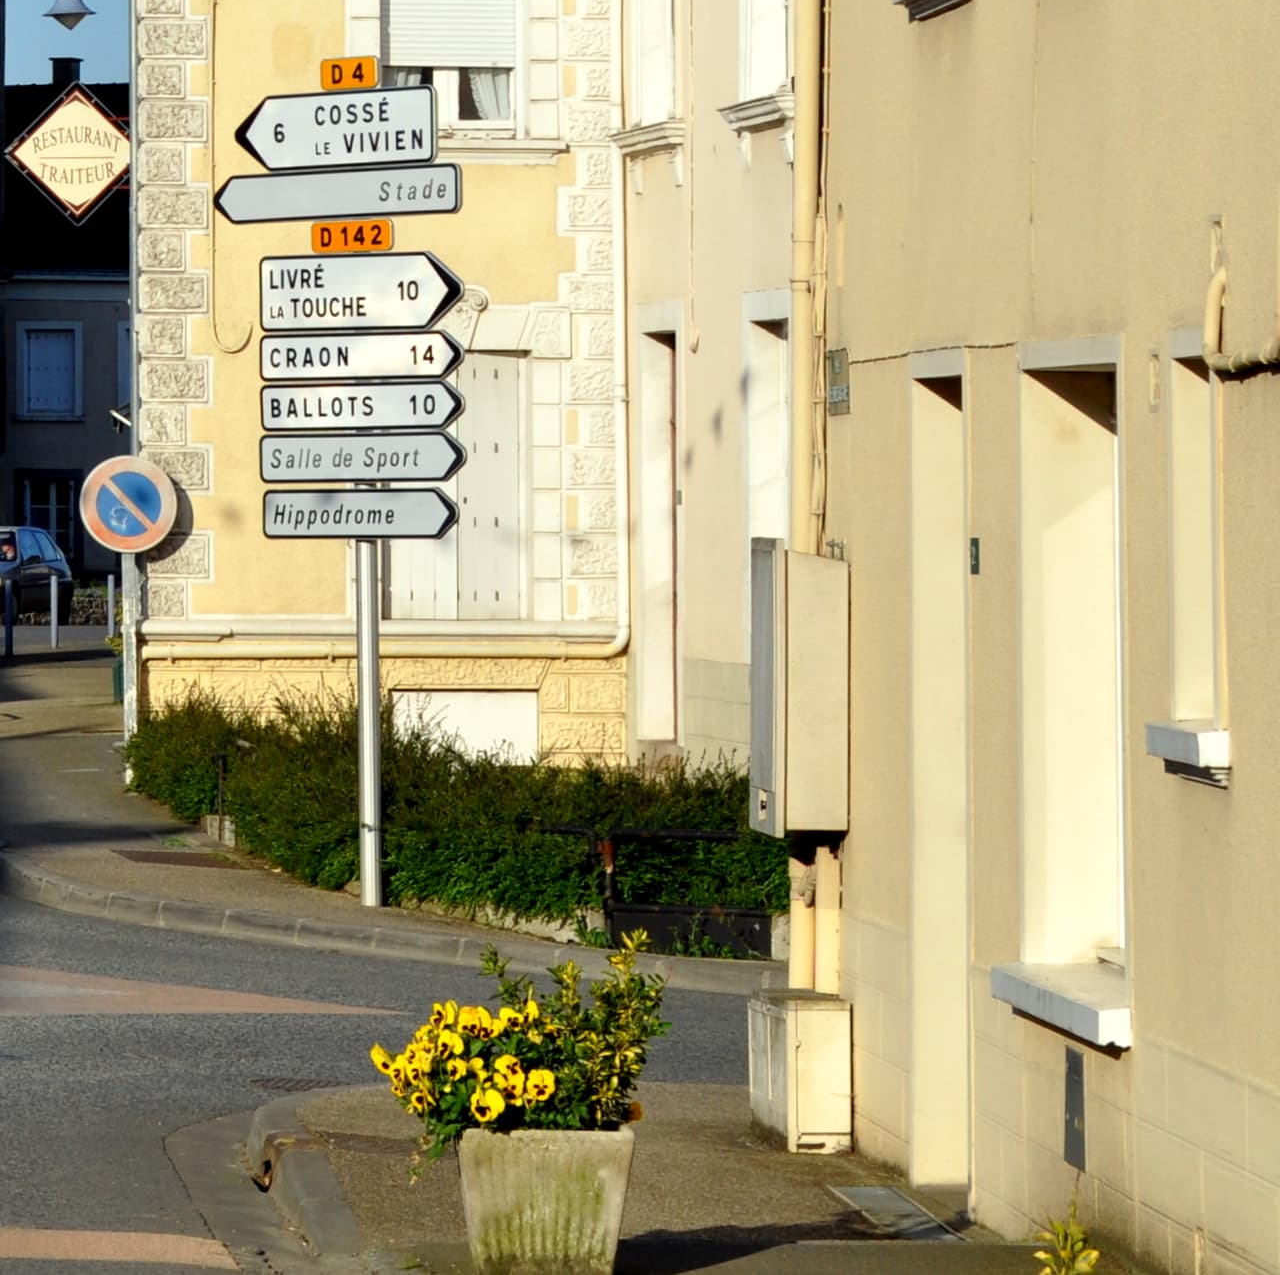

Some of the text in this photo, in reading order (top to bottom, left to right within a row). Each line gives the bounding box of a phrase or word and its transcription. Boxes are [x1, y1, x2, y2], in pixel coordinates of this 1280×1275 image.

[331, 62, 364, 84] D 4
[315, 96, 390, 126] COSSÉ
[32, 126, 121, 154] RESTAURANT
[273, 124, 285, 143] 6
[315, 129, 424, 156] LE VIVIEN
[40, 161, 115, 185] TRAITEUR
[379, 180, 447, 202] Stade
[320, 225, 383, 247] D 142
[269, 264, 325, 289] LIVRÉ
[397, 281, 419, 301] 10
[270, 297, 367, 319] LA TOUCHE
[270, 345, 435, 368] CRAON 14
[271, 395, 436, 418] BALLOTS 10
[270, 445, 421, 473] Salle de Sport
[273, 504, 395, 529] Hippodrome
